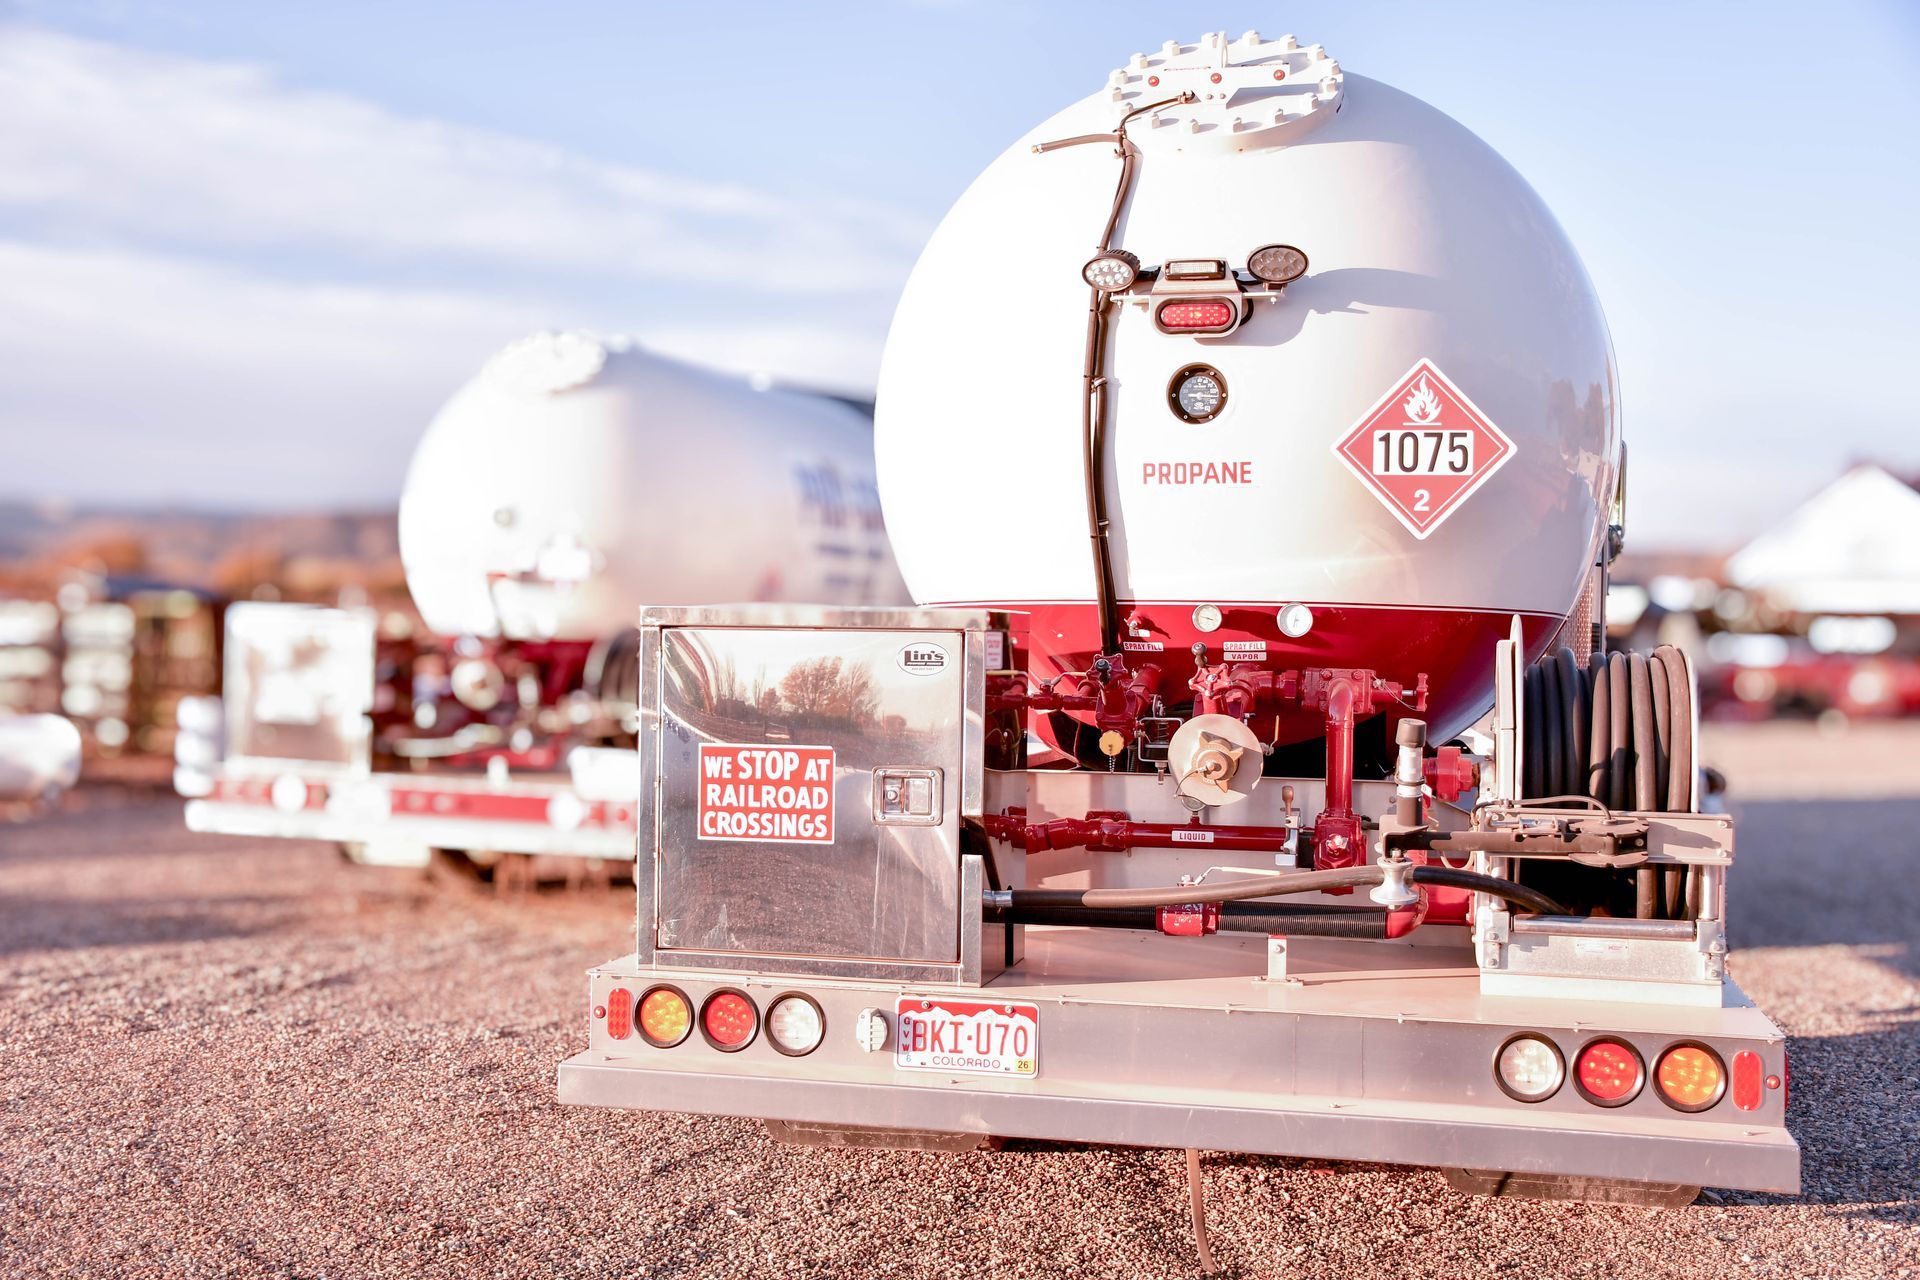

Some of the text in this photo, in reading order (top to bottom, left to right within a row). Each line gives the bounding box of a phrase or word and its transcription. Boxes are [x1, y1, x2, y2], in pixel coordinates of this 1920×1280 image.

[1378, 431, 1469, 473] 1075
[1143, 461, 1252, 484] PROPANE
[1413, 489, 1430, 511] 2
[1124, 642, 1162, 651] SPRAY FILL
[1224, 642, 1264, 650] SPRAY FILL
[904, 650, 944, 666] Lin's
[704, 750, 830, 781] WE STOP AT
[706, 783, 828, 809] RAILROAD
[703, 811, 828, 838] CROSSINGS
[1179, 832, 1206, 841] LIQUID
[932, 1055, 1001, 1069] COLORADO
[1017, 1060, 1029, 1069] 26
